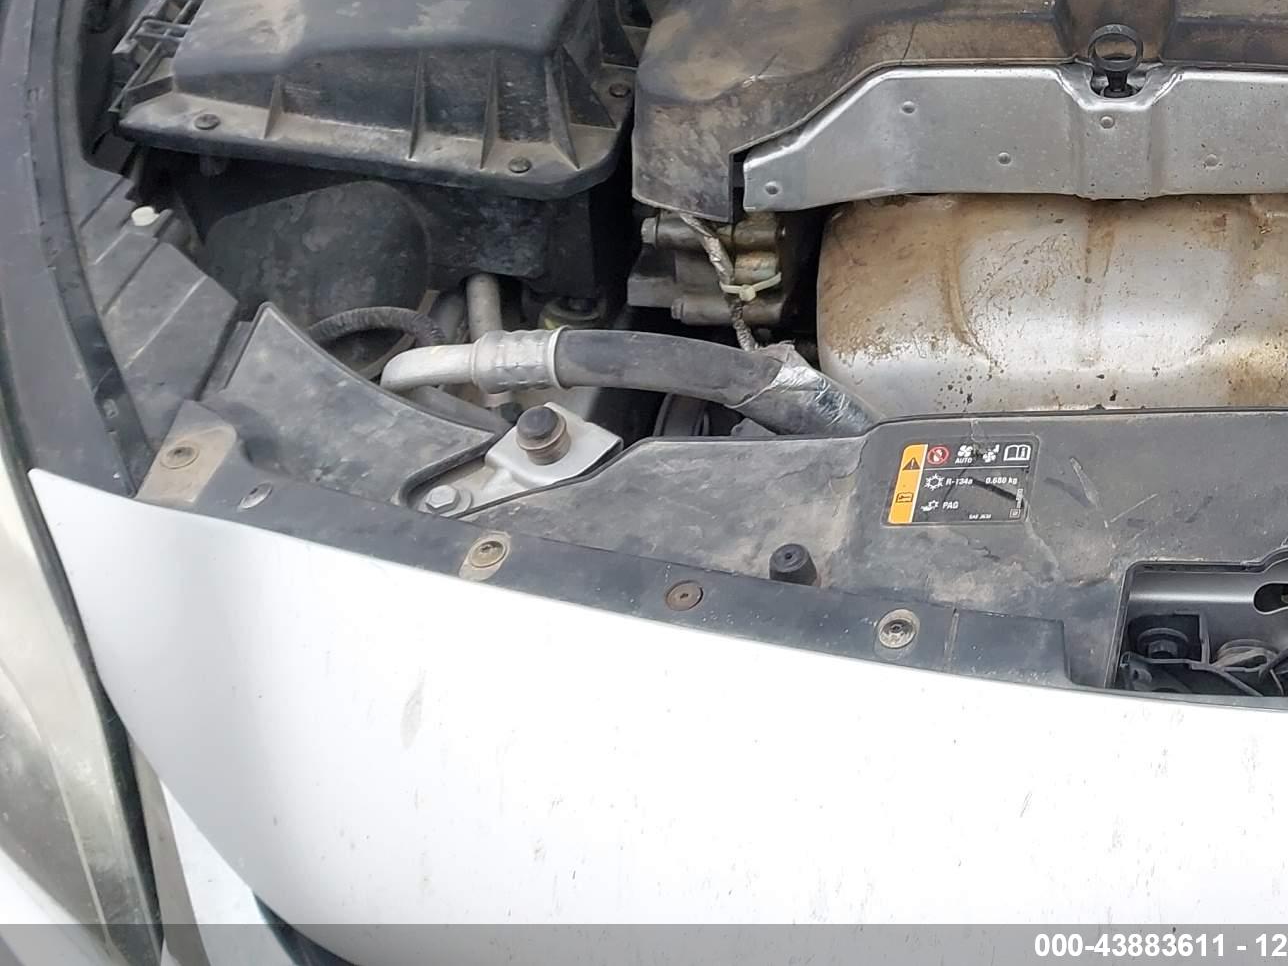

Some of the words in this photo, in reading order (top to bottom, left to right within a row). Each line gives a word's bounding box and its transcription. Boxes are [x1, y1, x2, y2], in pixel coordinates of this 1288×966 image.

[945, 477, 973, 485] R-134a
[1007, 476, 1018, 486] kg
[942, 501, 959, 510] PAG
